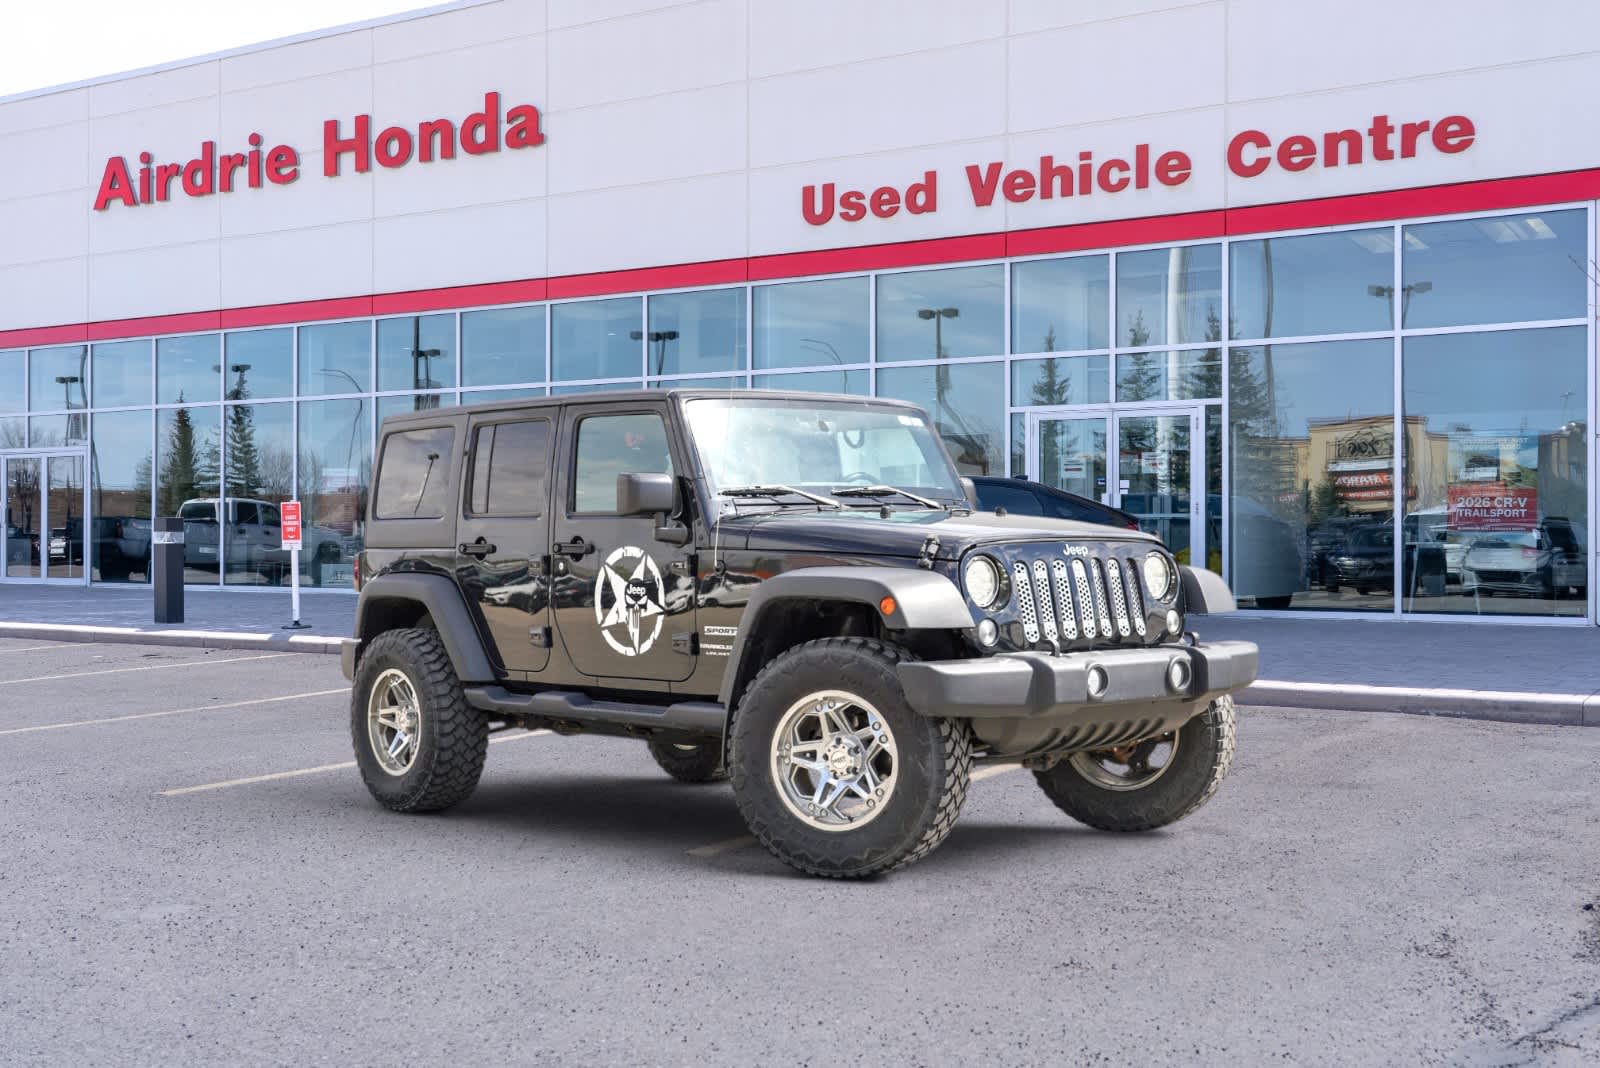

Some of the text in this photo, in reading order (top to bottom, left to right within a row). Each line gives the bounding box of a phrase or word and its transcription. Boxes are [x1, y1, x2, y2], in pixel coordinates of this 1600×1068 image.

[94, 91, 545, 211] Airdrie Honda
[802, 115, 1476, 226] Used Vehicle Centre
[1456, 496, 1528, 508] 2026 CR-V
[1456, 508, 1528, 518] TRAILSPORT
[1063, 543, 1089, 557] Jeep
[626, 583, 646, 597] Jeep
